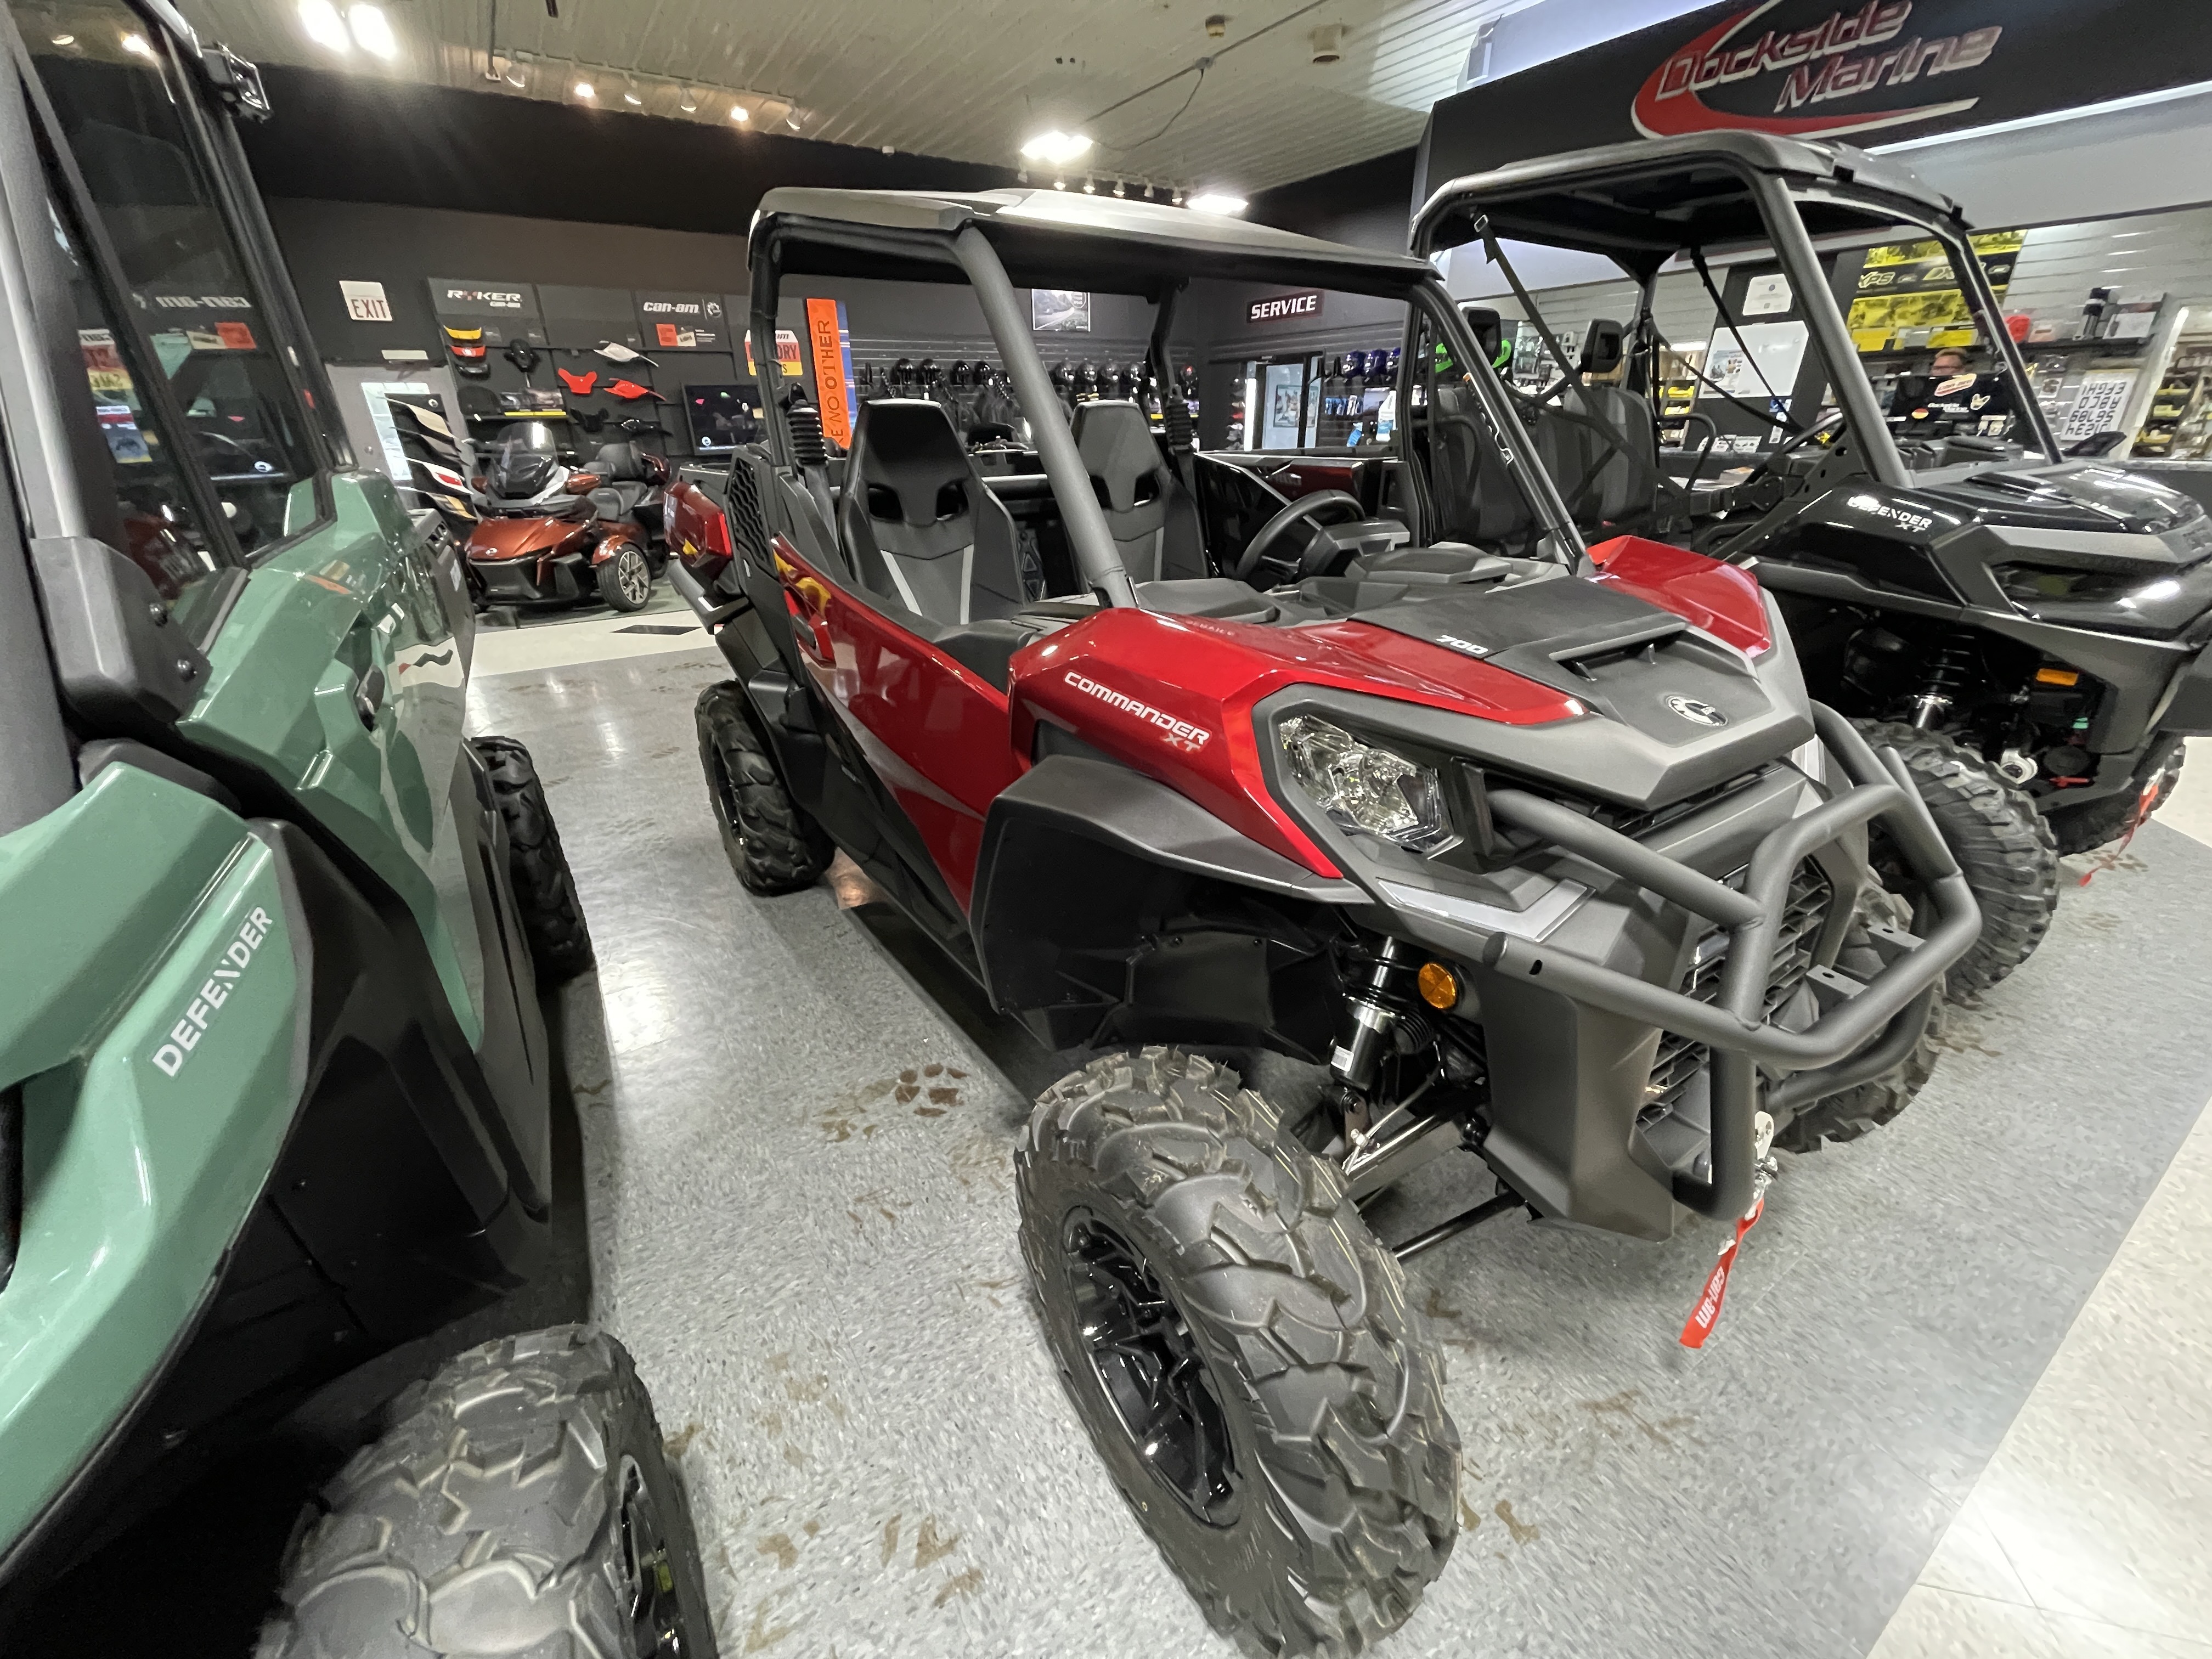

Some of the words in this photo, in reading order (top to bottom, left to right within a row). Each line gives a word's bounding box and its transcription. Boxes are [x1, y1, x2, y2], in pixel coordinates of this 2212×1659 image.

[1655, 0, 1912, 101] Dockside
[1774, 25, 2003, 113] Marine
[1858, 271, 1895, 289] XPS
[447, 290, 521, 302] RYKER
[643, 302, 699, 313] can-am
[1251, 295, 1317, 319] SERVICE
[351, 298, 387, 319] EXIT
[817, 320, 837, 390] OTHER
[827, 396, 842, 423] NO
[1895, 522, 1926, 533] XT
[1436, 634, 1488, 654] 700
[1064, 672, 1210, 745] COMMANDER
[1163, 732, 1201, 752] XT
[152, 906, 273, 1077] DEFENDER
[1695, 1266, 1725, 1329] can-am
